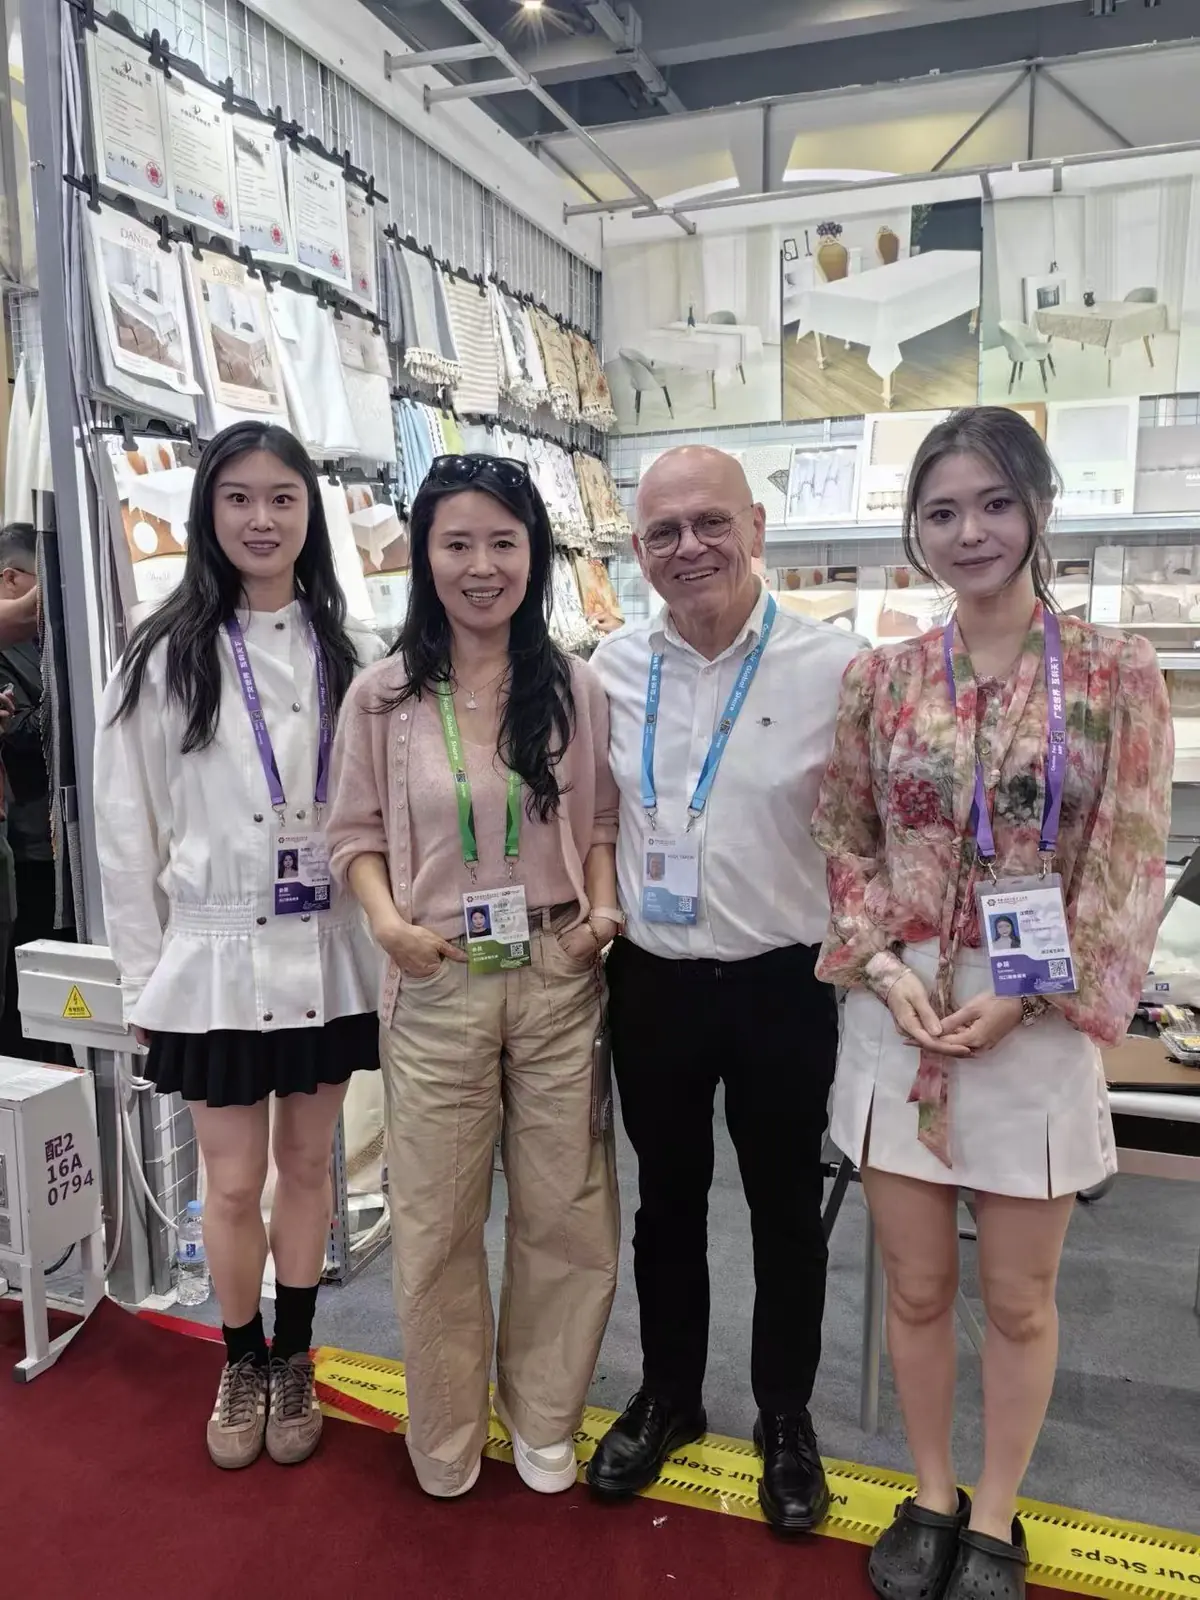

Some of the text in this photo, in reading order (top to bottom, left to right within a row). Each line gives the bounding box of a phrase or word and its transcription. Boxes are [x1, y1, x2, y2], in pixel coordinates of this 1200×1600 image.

[739, 664, 752, 689] Global
[728, 691, 742, 712] Share
[1052, 688, 1062, 719] 广交世界
[45, 1132, 74, 1163] 配2
[47, 1153, 83, 1184] 16A
[47, 1169, 94, 1206] 0794
[327, 1373, 381, 1391] Steps
[1069, 1548, 1148, 1575] Steps
